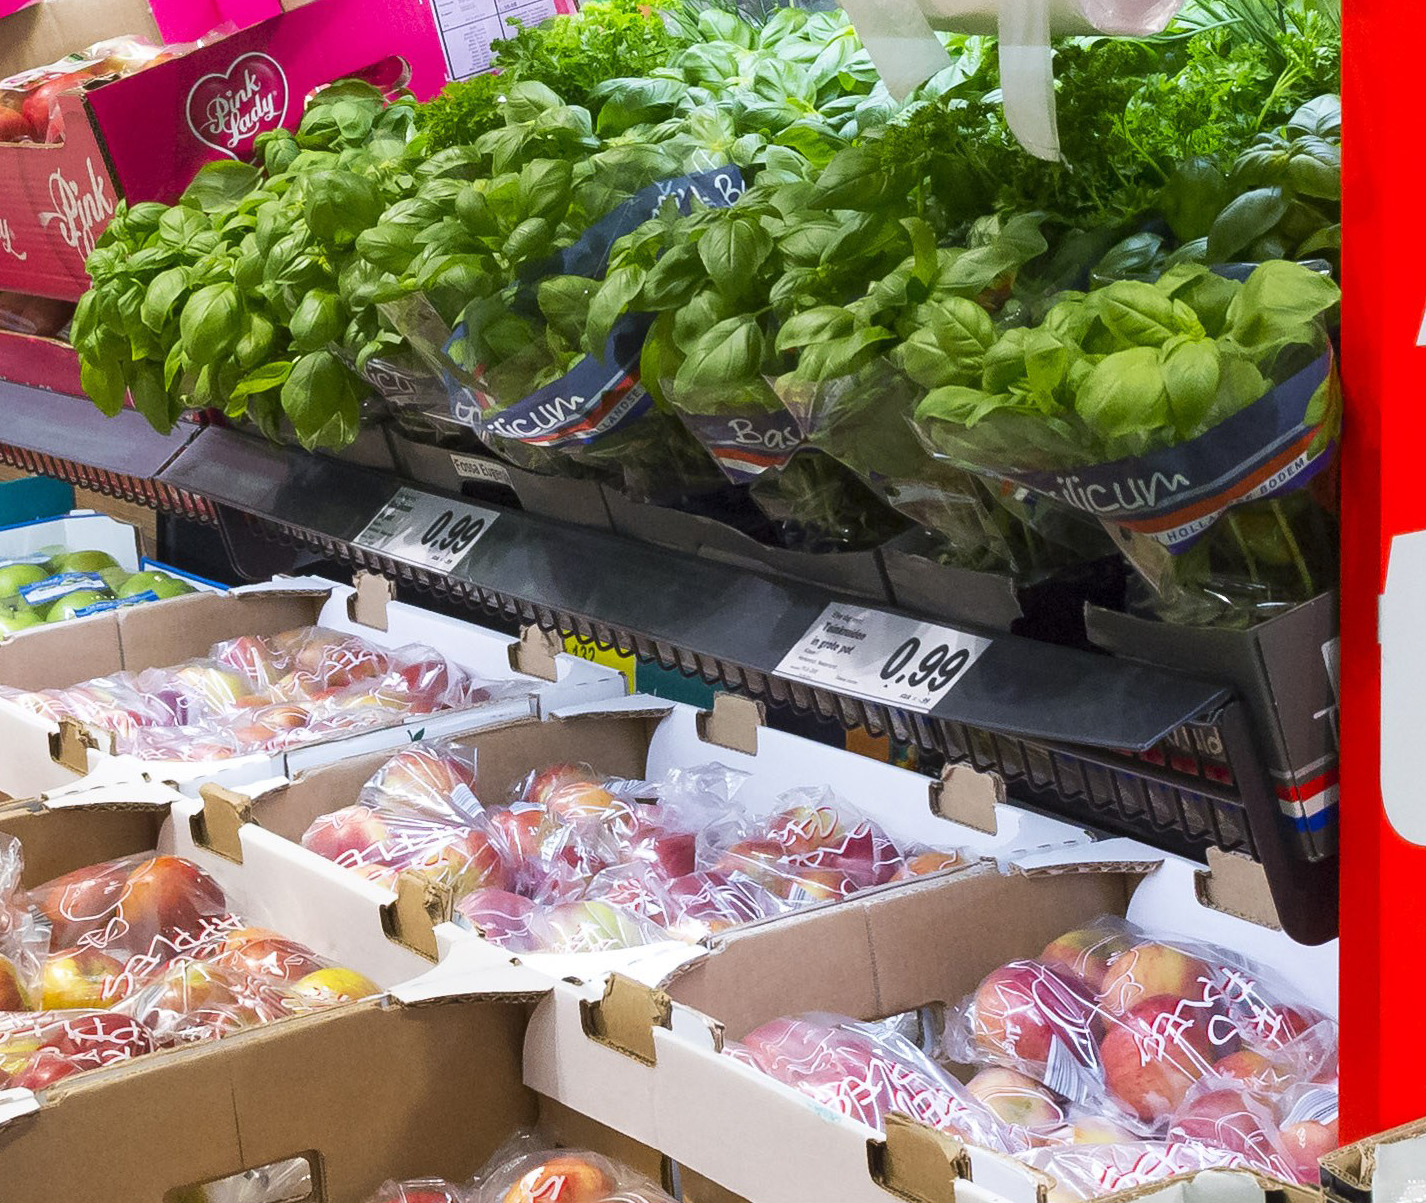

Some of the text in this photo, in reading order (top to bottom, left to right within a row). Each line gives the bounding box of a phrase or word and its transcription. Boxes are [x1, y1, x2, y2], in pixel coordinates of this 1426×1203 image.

[200, 69, 262, 134] Pink
[222, 93, 282, 148] Lady
[38, 157, 115, 249] Pink
[1260, 457, 1306, 495] BODEM
[421, 510, 486, 555] 0.99
[880, 637, 970, 693] 0.99
